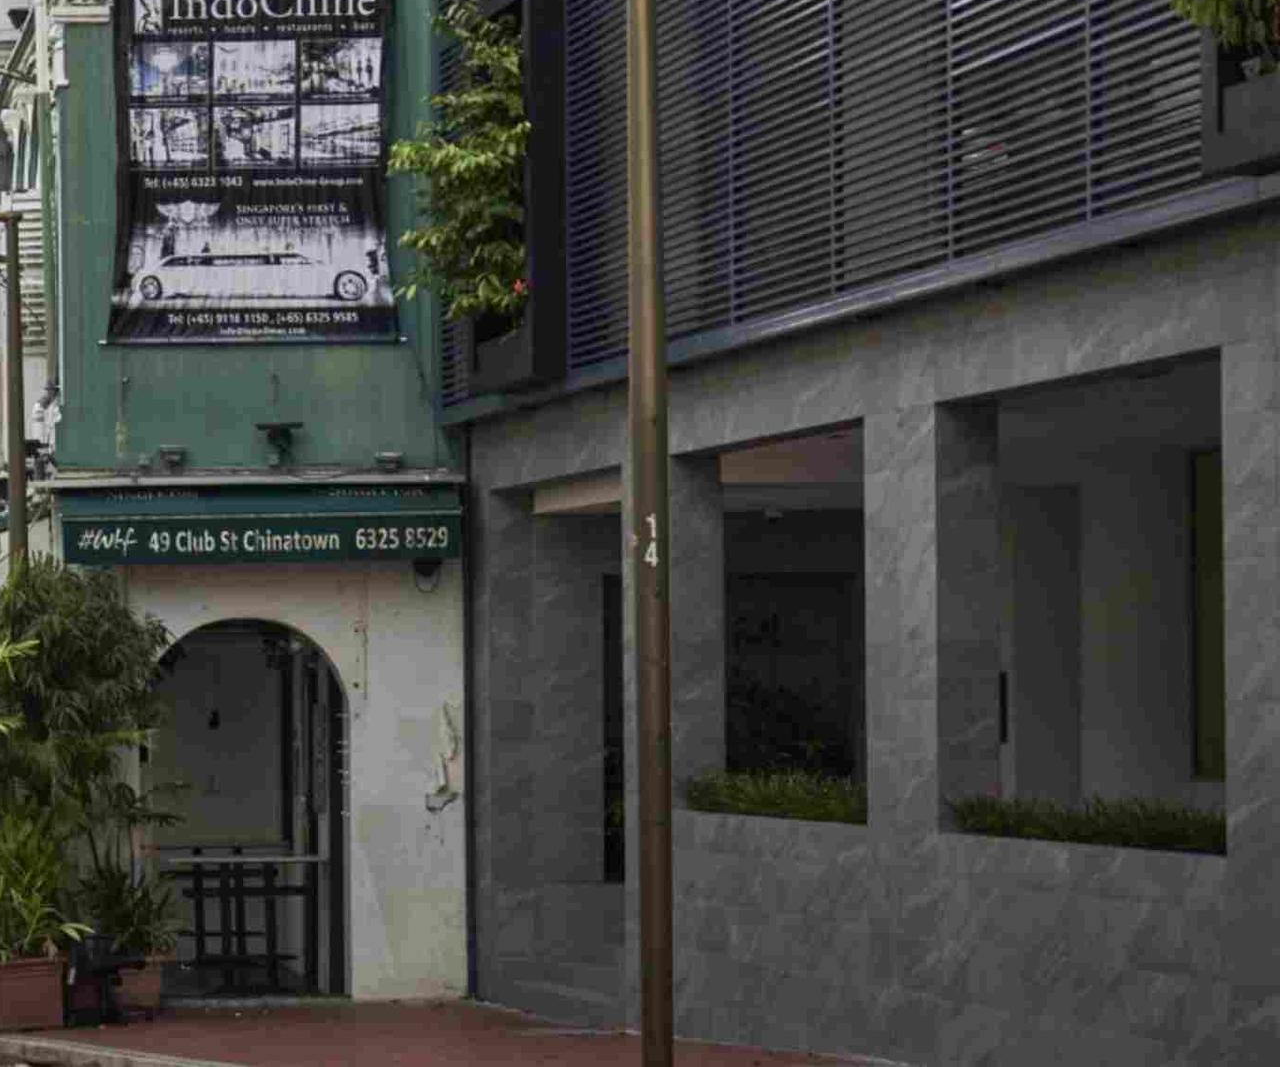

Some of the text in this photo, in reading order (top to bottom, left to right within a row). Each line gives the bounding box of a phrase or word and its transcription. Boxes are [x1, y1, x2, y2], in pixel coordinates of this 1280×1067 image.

[276, 23, 333, 32] restaurants
[148, 532, 170, 552] 49
[175, 529, 215, 551] Club
[219, 530, 238, 551] St
[243, 529, 340, 551] Chinatown
[355, 528, 399, 549] 6325
[406, 527, 449, 549] 8529
